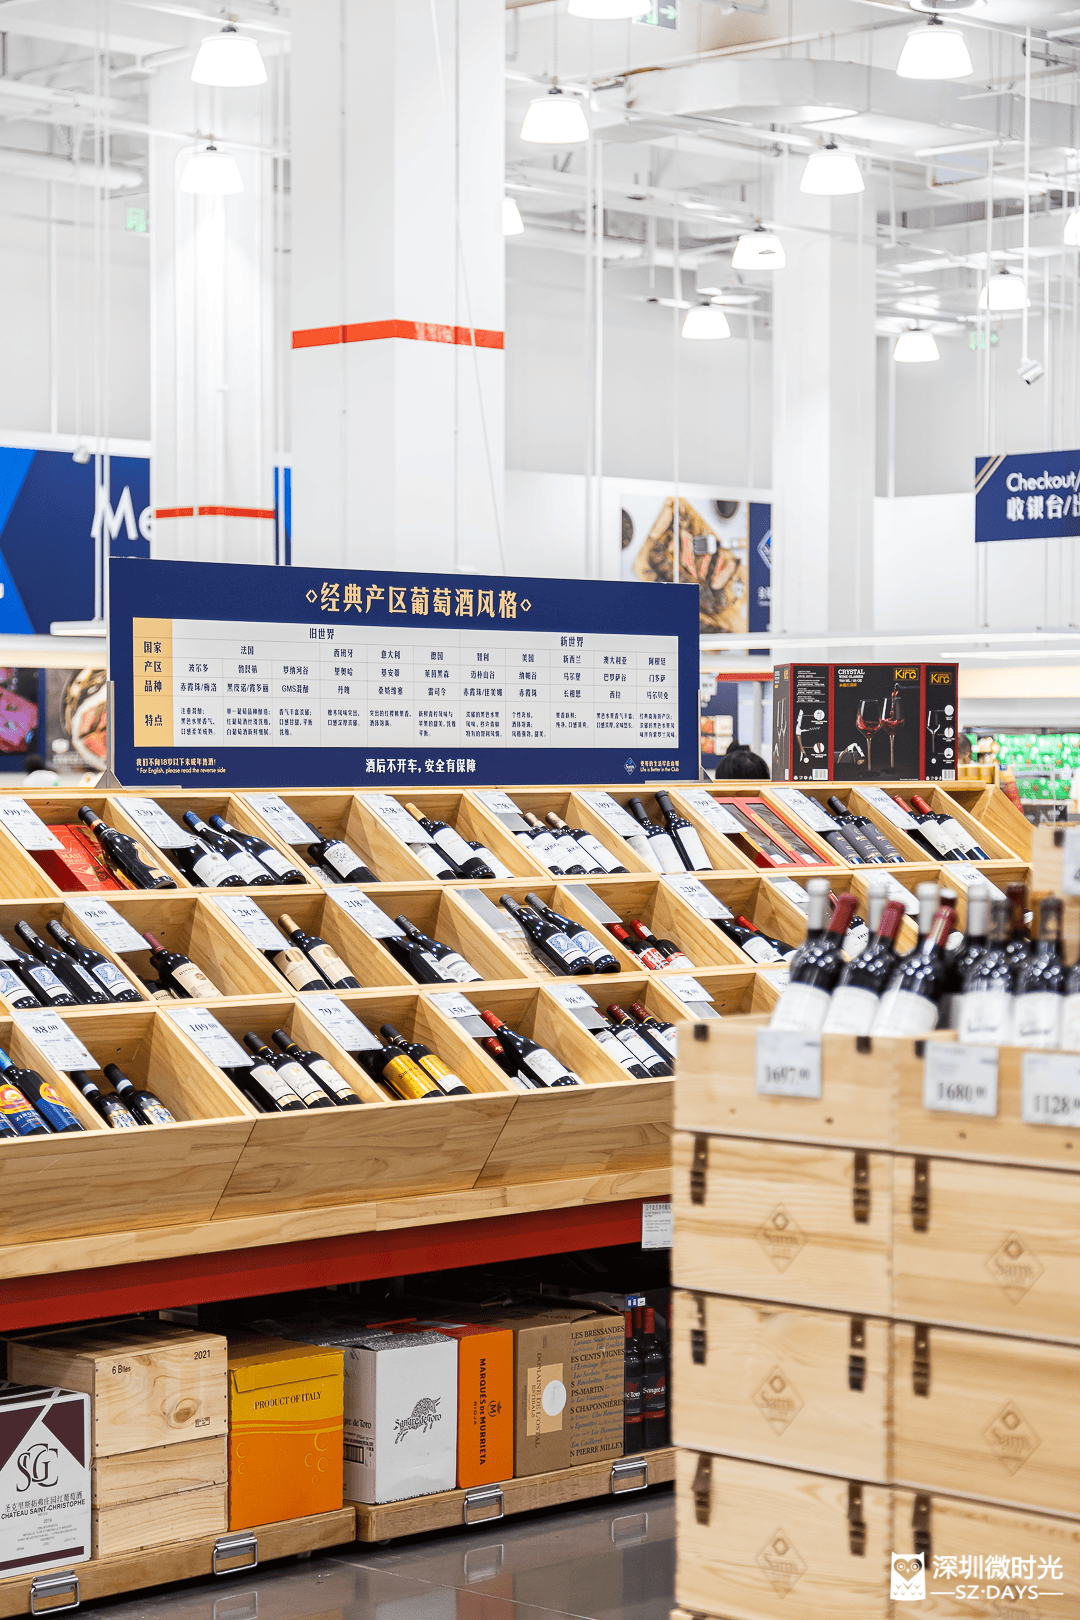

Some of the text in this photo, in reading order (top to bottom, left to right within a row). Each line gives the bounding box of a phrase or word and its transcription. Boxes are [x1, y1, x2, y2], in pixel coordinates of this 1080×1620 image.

[320, 582, 518, 619] 经典产区葡萄酒风格
[309, 628, 335, 640] 旧世界
[143, 640, 162, 654] 国家
[560, 636, 584, 648] 新世界
[240, 645, 254, 656] 法国
[333, 648, 353, 658] 西班牙
[380, 649, 401, 660] 意大利
[430, 651, 444, 661] 德国
[476, 652, 490, 662] 智利
[522, 653, 535, 663] 美国
[563, 654, 582, 664] 新西兰
[603, 656, 628, 666] 澳大利亚
[648, 656, 666, 666] 阿根廷
[144, 660, 162, 673] 产区
[188, 663, 209, 673] 波尔多
[238, 664, 258, 674] 勃艮第
[283, 665, 309, 676] 罗纳河谷
[518, 671, 537, 681] 纳帕谷
[563, 672, 581, 681] 马尔堡
[603, 673, 627, 682] 巴罗萨谷
[648, 674, 666, 683] 门多萨
[895, 669, 917, 680] King
[144, 679, 162, 692] 品种
[180, 682, 217, 693] 赤霞珠/梅洛
[227, 682, 269, 693] 黑皮诺/霞多丽
[281, 684, 309, 694] GMS混酿
[427, 687, 447, 697] 雷司令
[518, 688, 538, 698] 赤霞珠
[563, 689, 582, 699] 长相思
[610, 690, 621, 700] 西拉
[646, 691, 669, 701] 马尔贝克
[145, 714, 163, 727] 特点
[365, 758, 476, 773] 酒后不开车，安全有保障
[32, 1024, 58, 1034] 88.00
[766, 1065, 810, 1086] 1697.00
[936, 1081, 987, 1102] 1680.00
[571, 1325, 625, 1339] LES BRESSANDES
[194, 1350, 210, 1360] 2021
[580, 1353, 601, 1362] CENTS
[602, 1350, 625, 1359] VIGNES
[112, 1366, 116, 1374] 6
[479, 1358, 487, 1402] MARQUÉS
[571, 1385, 604, 1397] PS-MARTIN
[631, 1391, 640, 1399] Toro
[254, 1391, 322, 1410] PRODUCT OF ITALY
[535, 1397, 542, 1410] DE
[576, 1399, 625, 1413] CHAPONNIÈRES
[353, 1419, 360, 1427] de
[360, 1419, 372, 1429] Toro
[576, 1445, 598, 1456] PIERRE
[600, 1441, 623, 1452] MILLEY
[1, 1499, 86, 1520] CHATEAU SAINT-CHRISTOPHE
